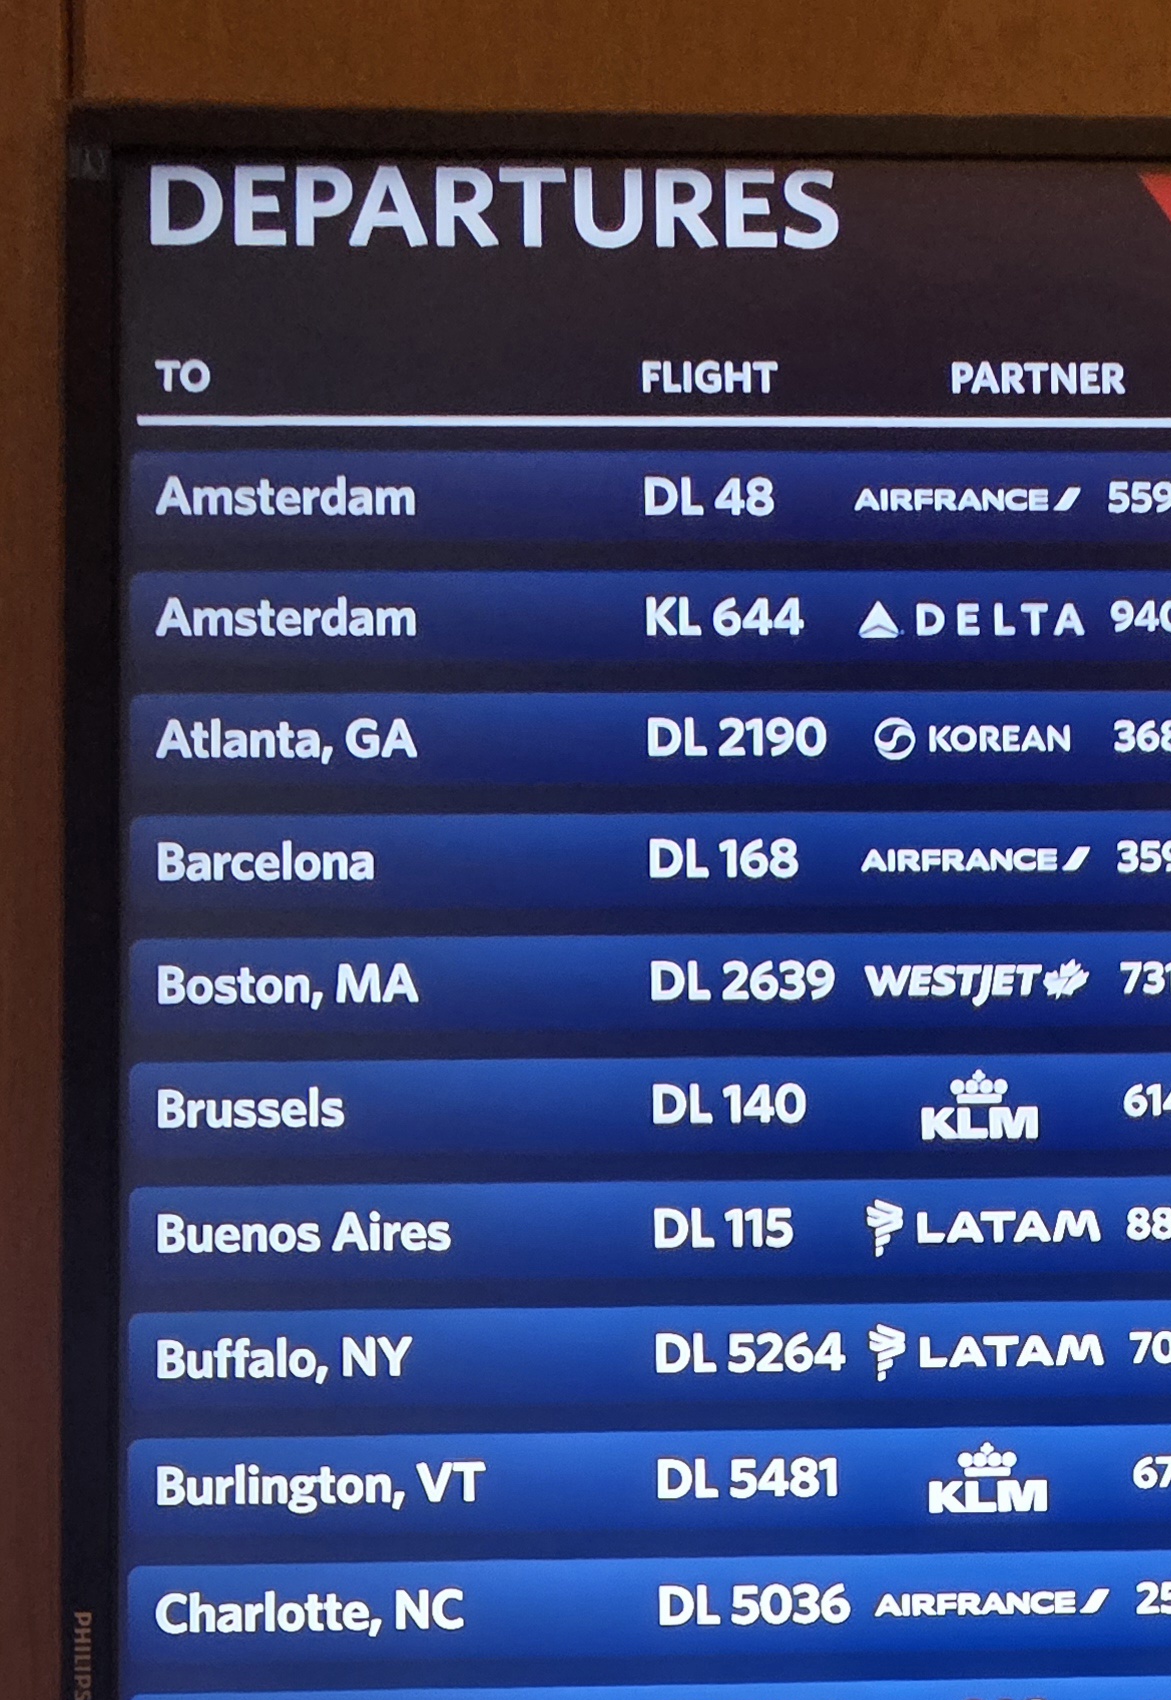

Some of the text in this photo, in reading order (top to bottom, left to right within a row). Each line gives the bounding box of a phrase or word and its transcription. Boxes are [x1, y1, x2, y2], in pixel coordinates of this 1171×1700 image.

[150, 165, 840, 250] DEPARTURES
[154, 358, 211, 393] TO
[641, 359, 779, 394] FLIGHT
[951, 360, 1126, 395] PARTNER
[155, 474, 416, 516] Amsterdam
[644, 476, 775, 517] DL 48
[155, 595, 417, 637] Amsterdam
[645, 596, 805, 637] KL 644
[916, 602, 1085, 637] DELTA
[155, 717, 418, 765] Atlanta, GA
[928, 724, 1071, 753] KOREAN
[157, 839, 375, 882] Barcelona
[157, 962, 419, 1011] Boston, MA
[650, 959, 836, 1001] DL 2639
[864, 963, 1043, 1007] WESTJET
[157, 1085, 345, 1129] Brussels
[920, 1105, 1039, 1141] KLM
[157, 1210, 452, 1254] Buenos Aires
[916, 1209, 1102, 1244] LATAM
[156, 1335, 413, 1385] Buffalo, NY
[919, 1333, 1105, 1368] LATAM
[156, 1460, 487, 1514] Burlington, VT
[928, 1479, 1048, 1514] KLM
[155, 1587, 465, 1638] Charlotte, NC
[658, 1582, 851, 1626] DL 5036
